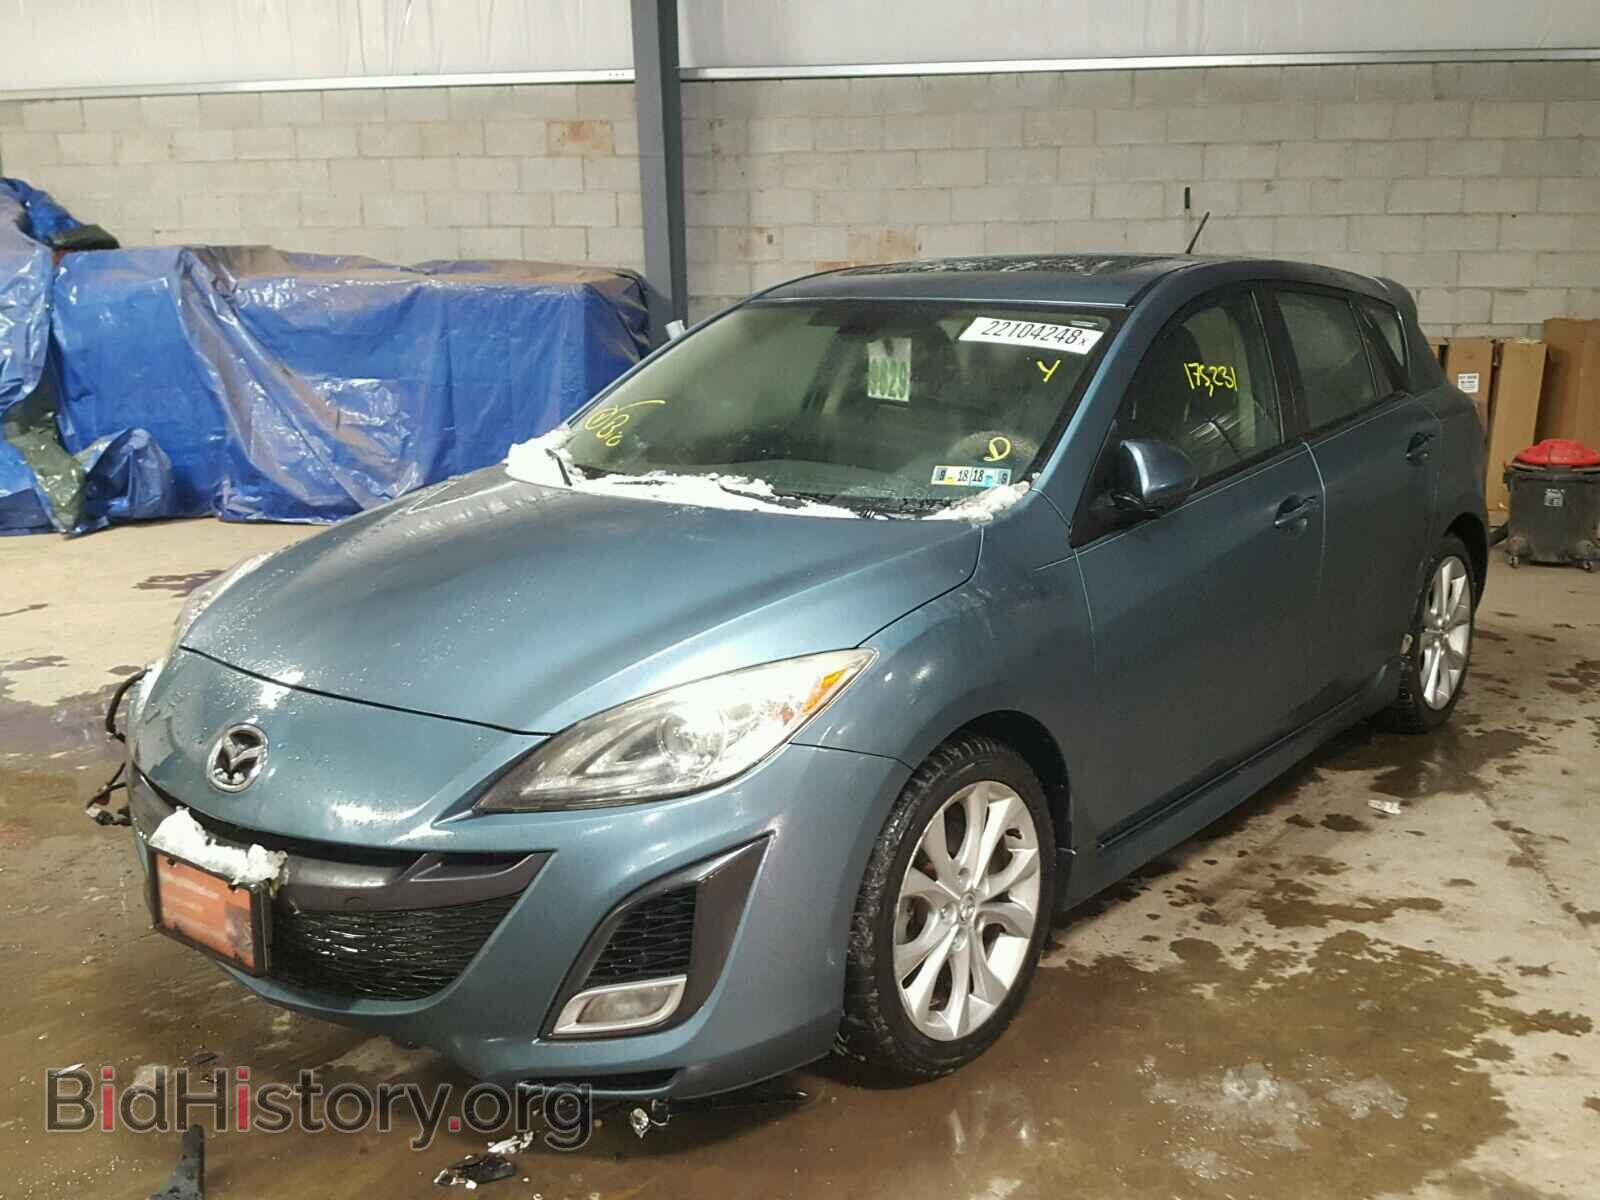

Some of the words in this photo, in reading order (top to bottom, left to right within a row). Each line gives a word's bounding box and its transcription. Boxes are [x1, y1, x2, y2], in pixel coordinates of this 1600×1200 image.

[1183, 362, 1238, 397] 175,231
[957, 469, 969, 482] 18
[972, 469, 985, 482] 18
